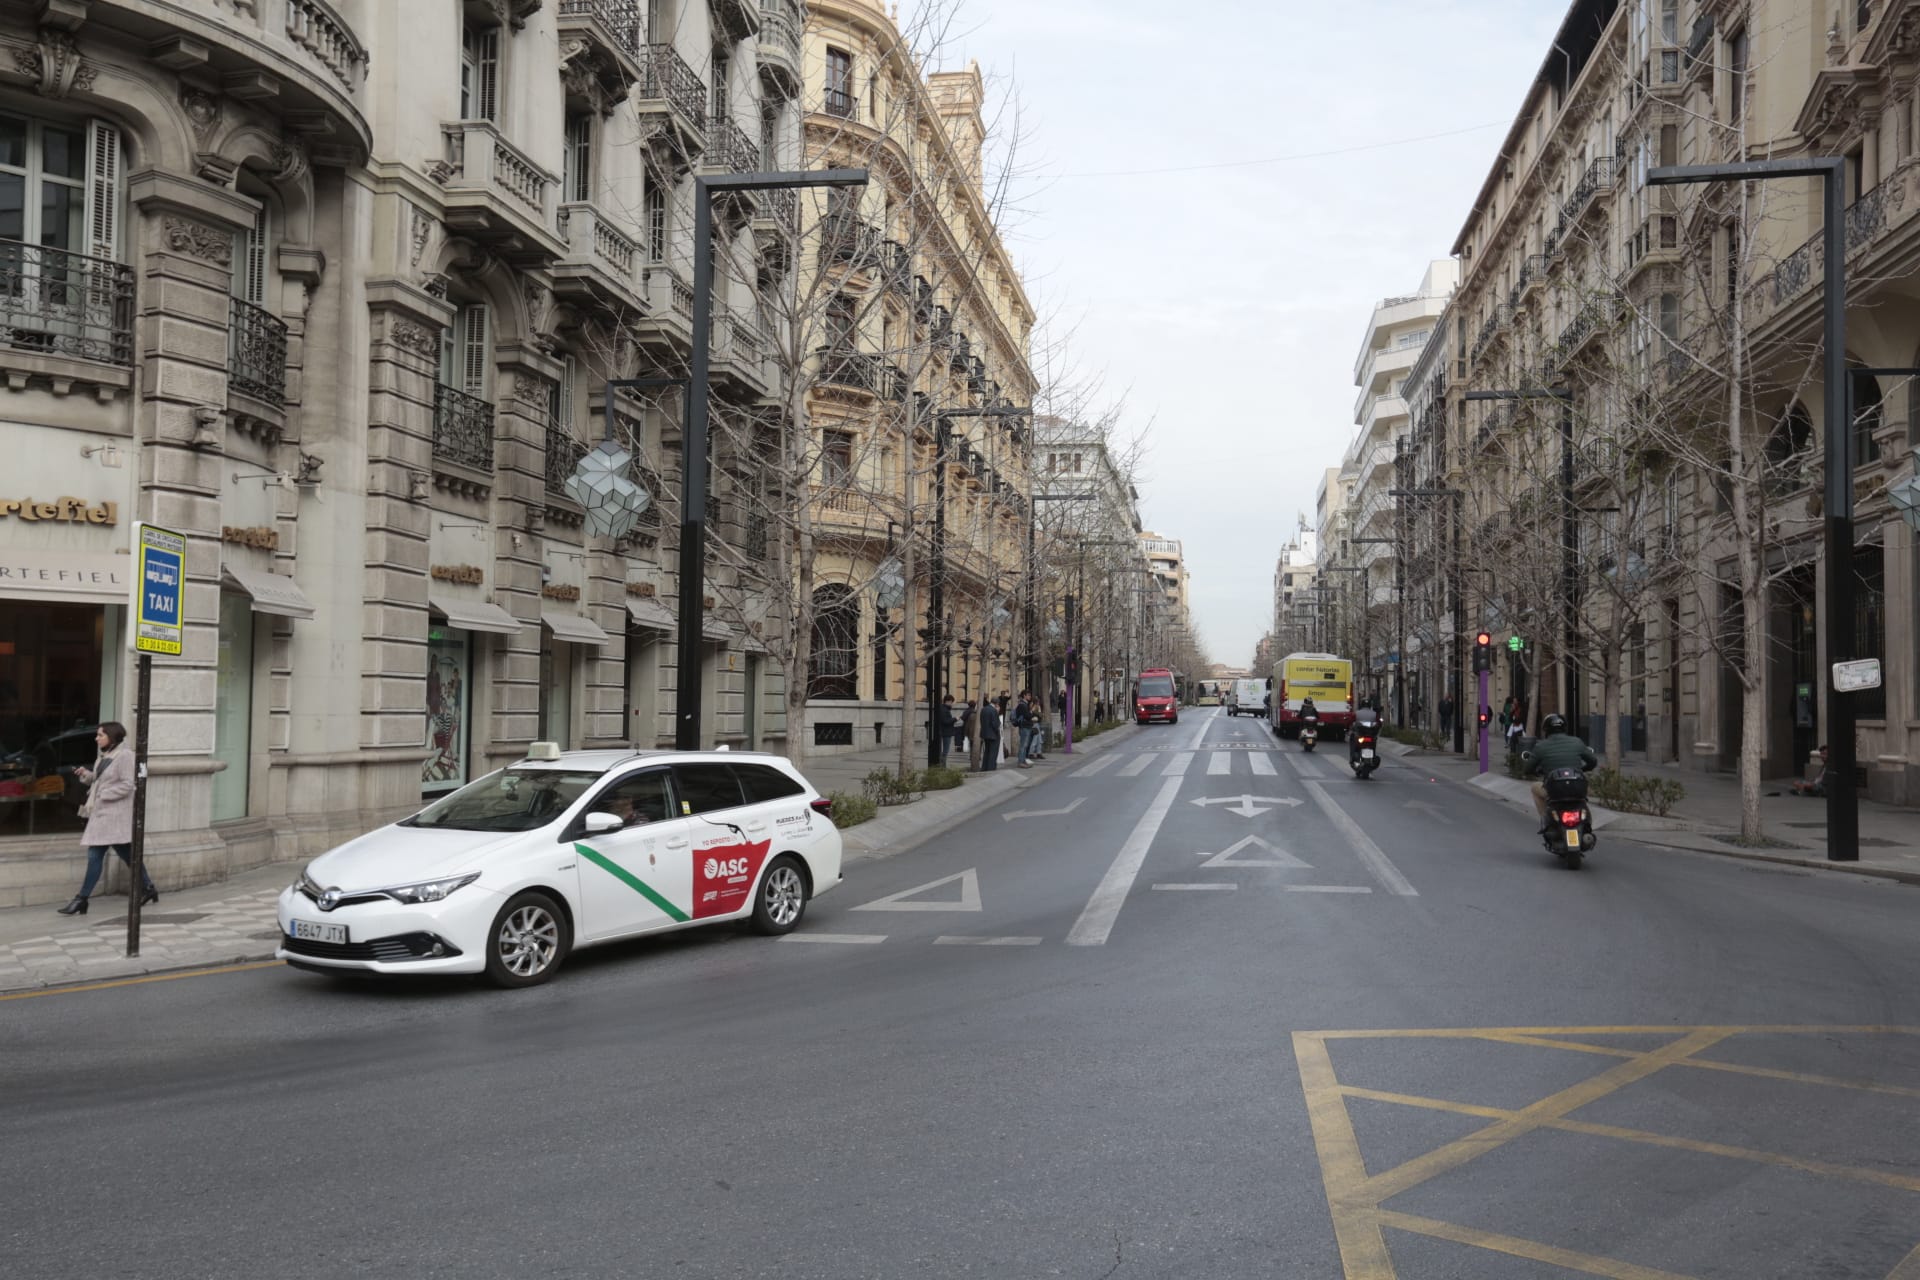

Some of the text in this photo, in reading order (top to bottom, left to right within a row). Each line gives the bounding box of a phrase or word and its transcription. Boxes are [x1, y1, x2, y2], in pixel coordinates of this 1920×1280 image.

[148, 592, 174, 612] TAXI
[717, 858, 748, 878] ASC
[298, 922, 344, 942] 6647 JTX
